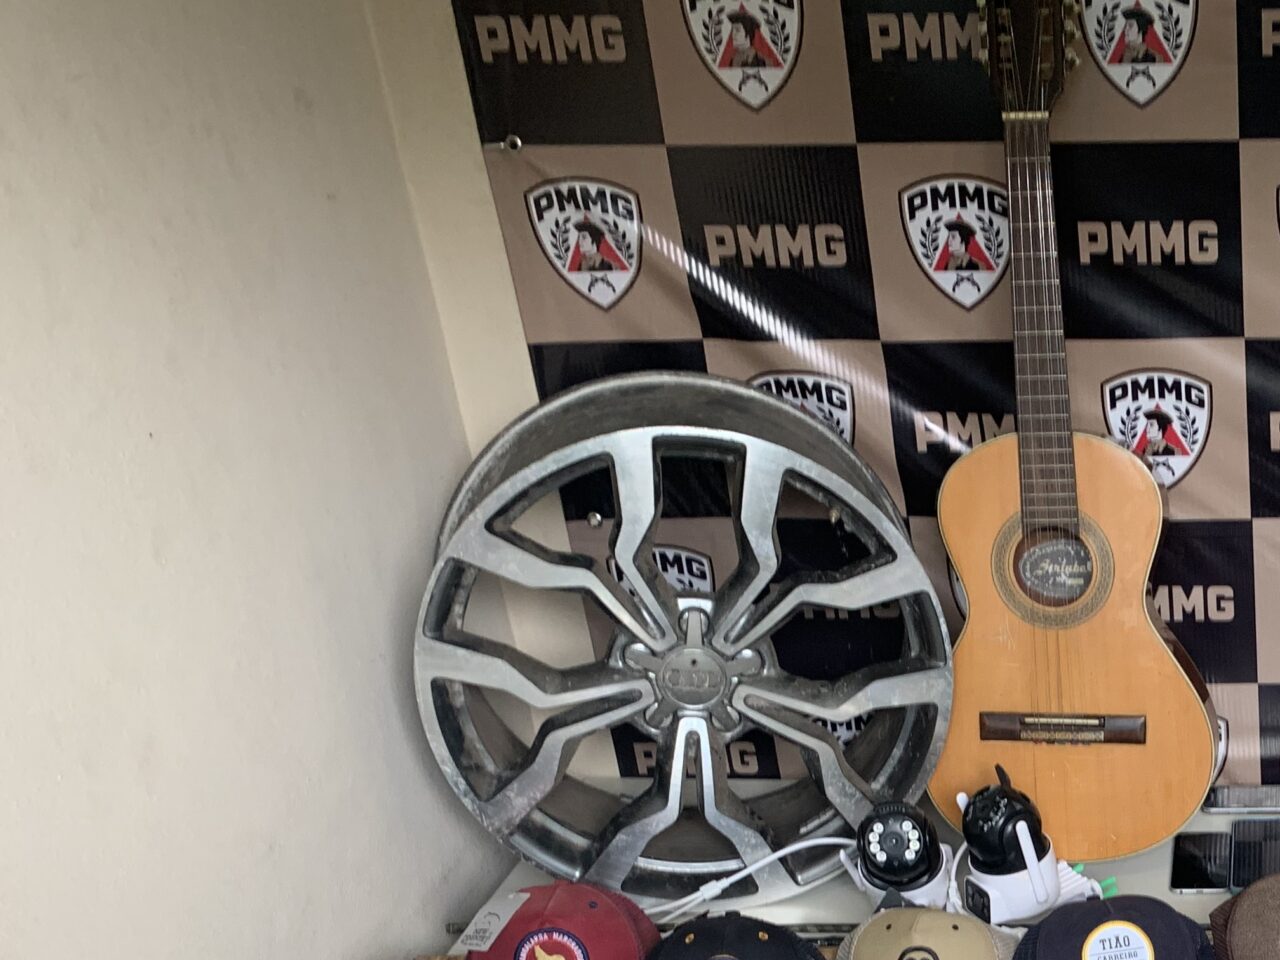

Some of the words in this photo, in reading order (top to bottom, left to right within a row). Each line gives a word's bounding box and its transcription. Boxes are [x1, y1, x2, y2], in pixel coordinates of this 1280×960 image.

[475, 15, 626, 62] PMMG
[866, 13, 981, 61] PMM
[533, 185, 635, 223] PMMG
[907, 178, 1008, 220] PMMG
[704, 224, 848, 267] PMMG
[1078, 220, 1218, 264] PMMG
[1107, 377, 1206, 411] PMMG
[914, 410, 1015, 453] PMM
[1153, 585, 1235, 622] MMG
[1100, 933, 1131, 951] TIÃO
